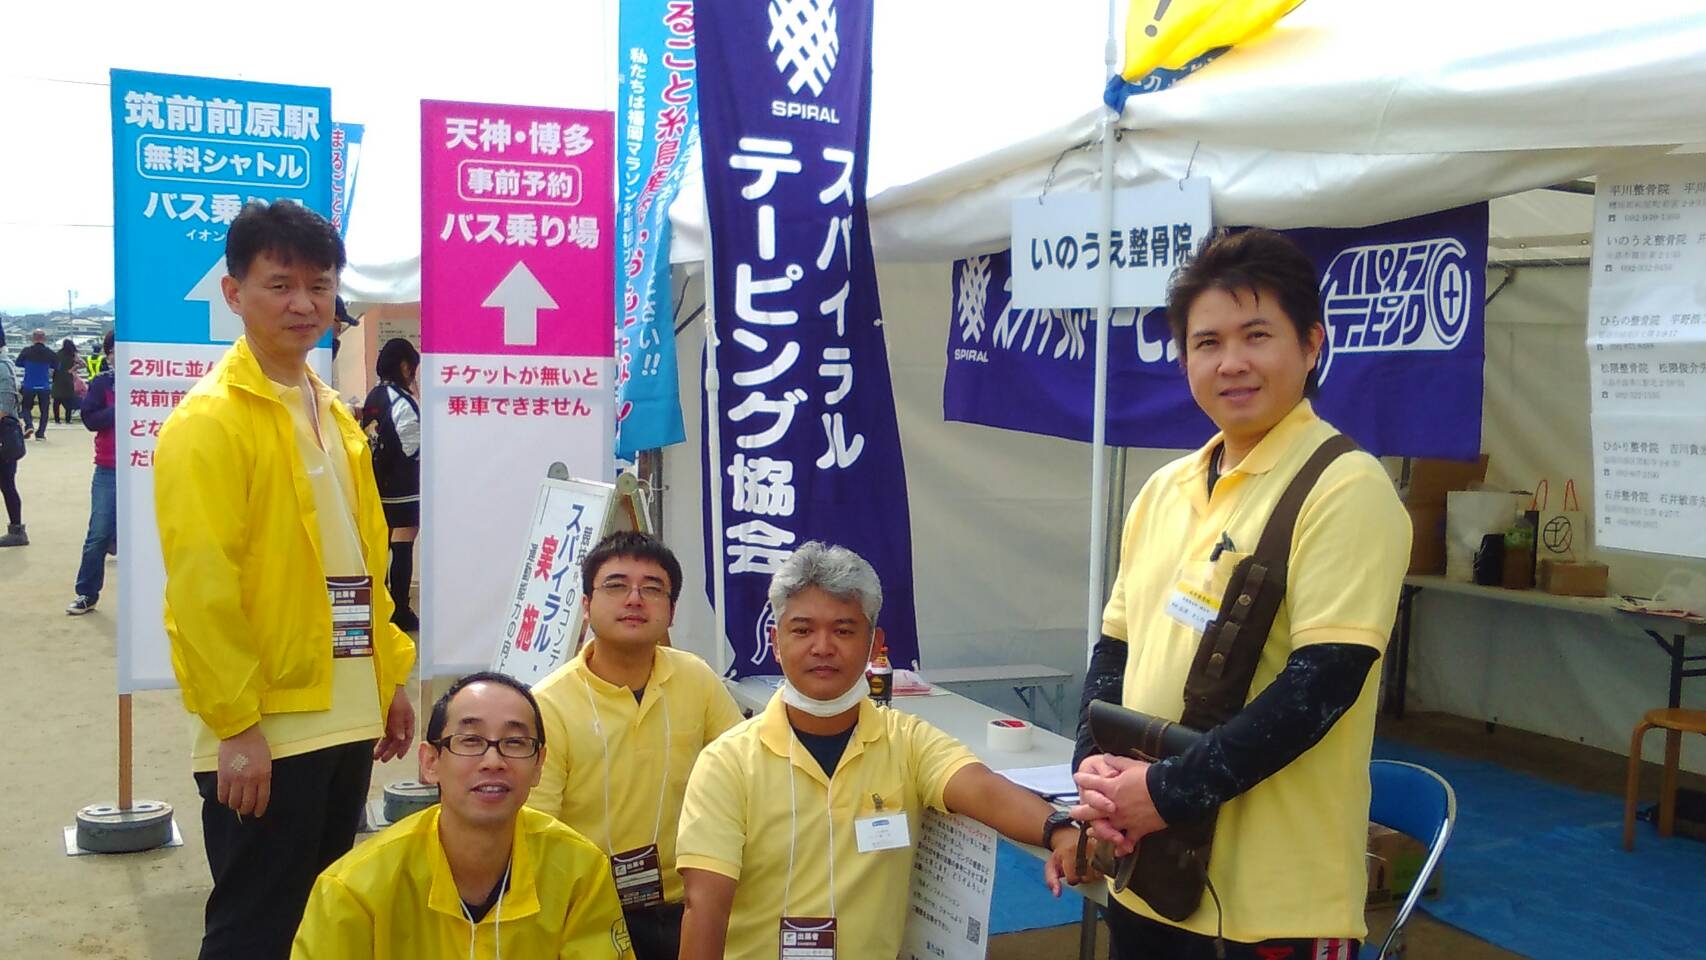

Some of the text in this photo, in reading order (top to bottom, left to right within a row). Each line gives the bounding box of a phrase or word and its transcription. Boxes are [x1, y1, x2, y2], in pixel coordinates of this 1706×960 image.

[124, 91, 321, 142] 筑前前原駅
[771, 100, 840, 124] SPIRAL
[445, 117, 595, 157] 天神・博多
[143, 143, 304, 180] 無料シャトル
[467, 167, 574, 199] 事前予約
[439, 212, 601, 250] バス乗り場
[1031, 222, 1194, 271] いのうえ整骨院
[816, 147, 866, 470] スパイラル
[726, 137, 809, 575] テーピング協会
[953, 348, 990, 363] SPIRAL
[440, 364, 599, 387] チケットが無いと
[447, 395, 592, 418] 乗車できません
[532, 503, 585, 654] スパイラル
